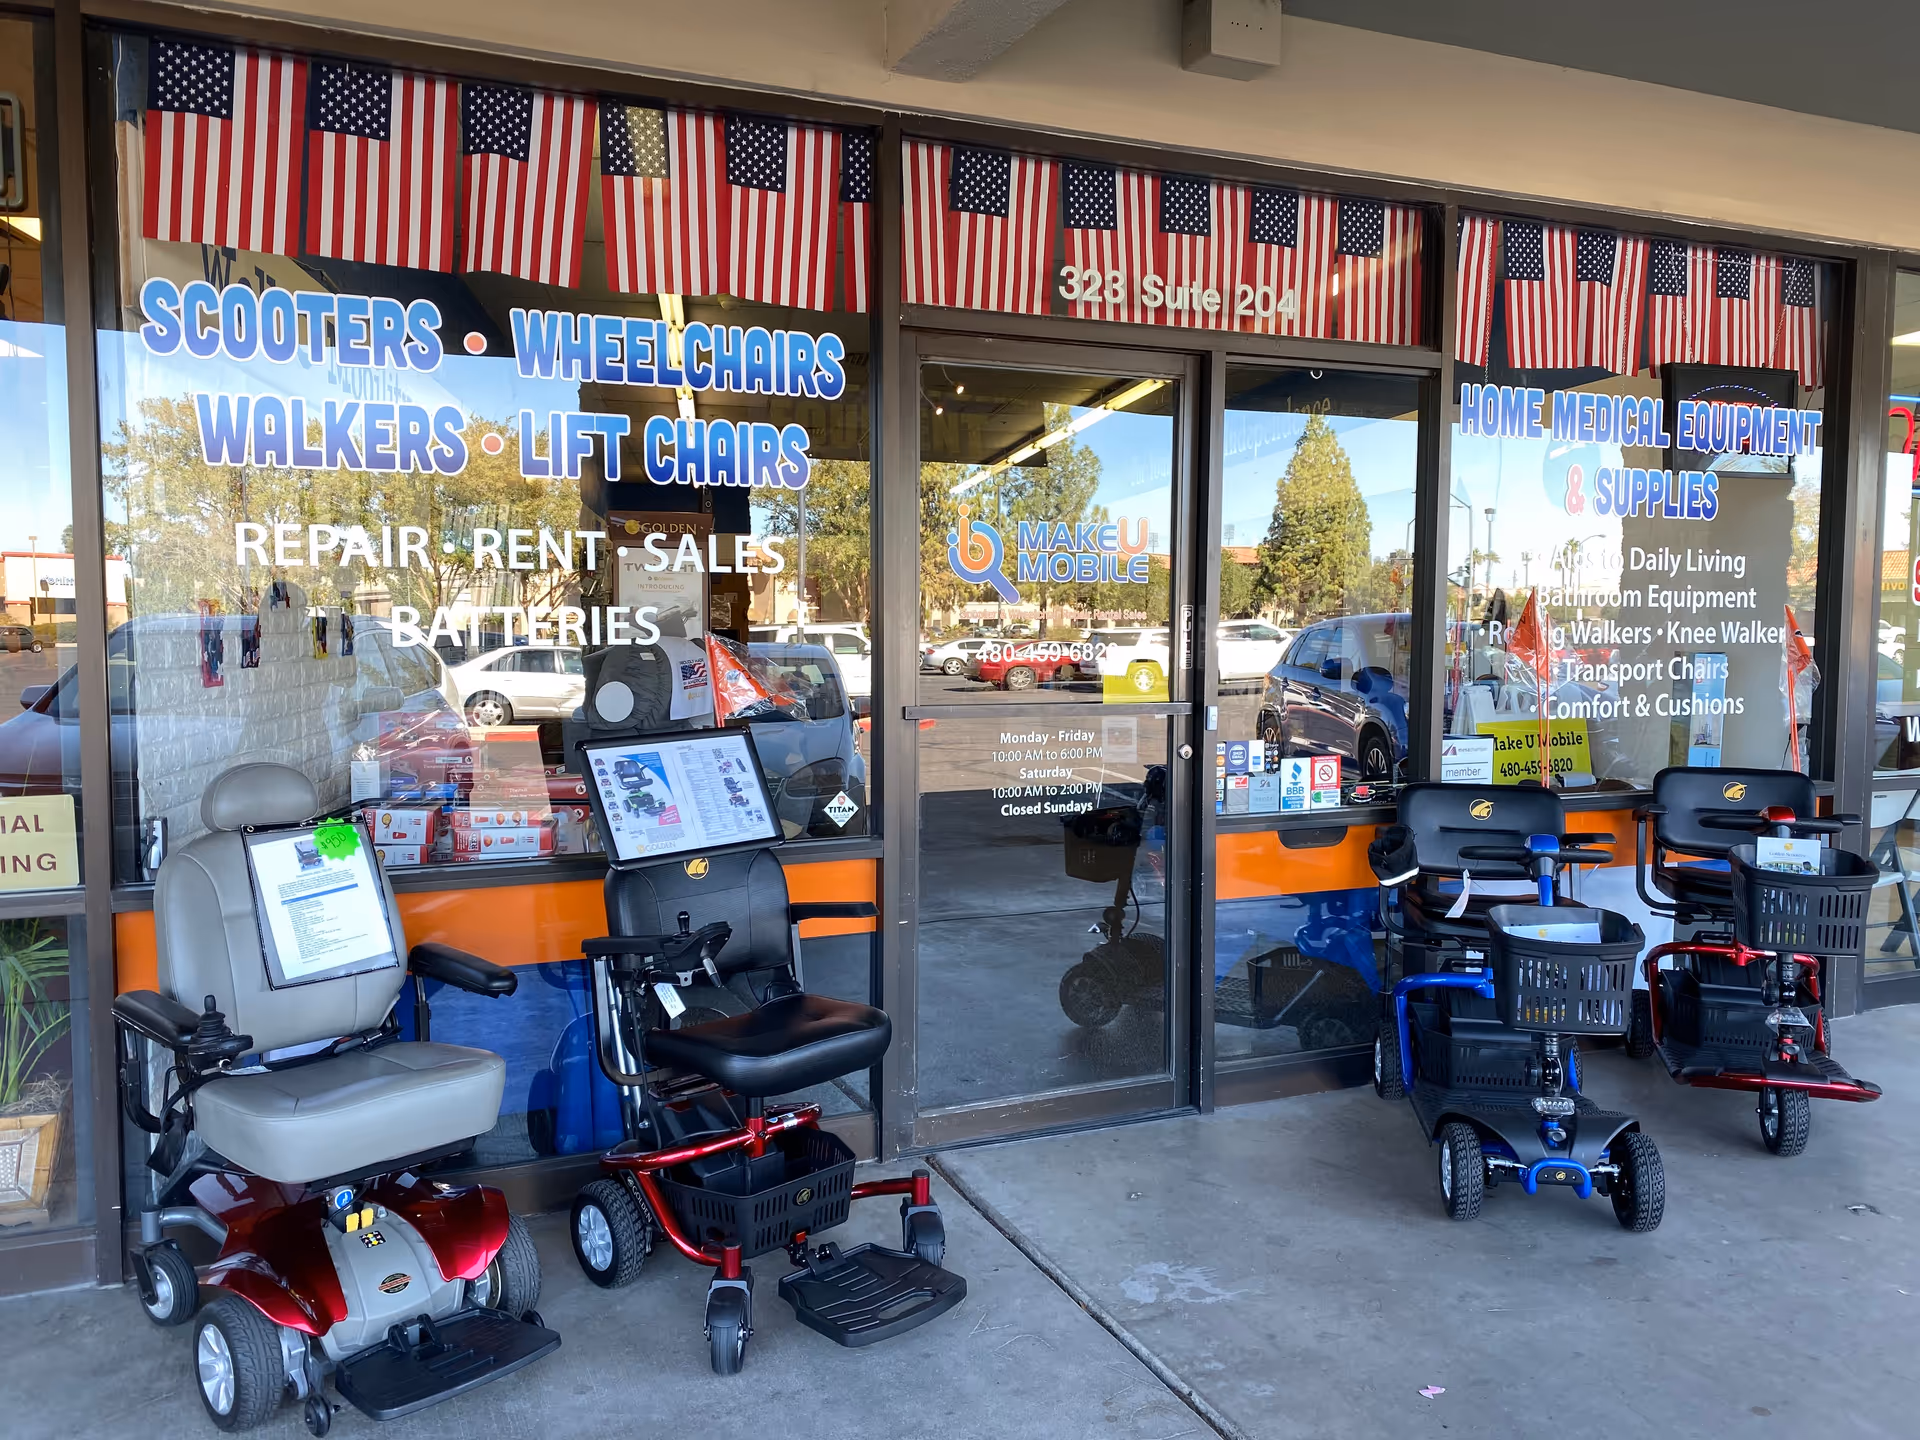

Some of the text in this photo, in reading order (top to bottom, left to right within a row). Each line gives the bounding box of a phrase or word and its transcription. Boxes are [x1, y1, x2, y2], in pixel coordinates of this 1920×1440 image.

[1058, 265, 1296, 319] 323 Suite 204
[139, 277, 443, 373] SCOOTERS
[509, 308, 846, 400] WHEELCHAIRS
[1460, 383, 1545, 439] HOME
[1552, 389, 1671, 449] MEDICAL
[1677, 399, 1823, 456] EQUIPMENT
[193, 392, 468, 476] WALKERS
[518, 409, 630, 482] LIFT
[644, 415, 811, 490] CHAIRS
[1566, 464, 1719, 521] & SUPPLIES
[640, 522, 697, 535] GOLDEN
[235, 522, 785, 575] REPAIR RENT SALES
[624, 562, 696, 573] TWGHT
[1017, 552, 1149, 584] MOBILE
[1630, 546, 1682, 577] Daily
[1686, 548, 1746, 578] Living
[1536, 584, 1757, 613] Bathroom Equipment
[392, 605, 661, 648] BATTERIES
[1094, 609, 1122, 621] Rental
[1123, 610, 1147, 621] Sales
[1570, 620, 1651, 645] Walkers
[1667, 621, 1717, 644] Knee
[975, 641, 1120, 663] 480-459-682
[1562, 655, 1729, 687] Transport Chairs
[1543, 693, 1744, 720] Comfort & Cushions
[1000, 731, 1049, 745] Monday
[1058, 730, 1095, 743] Friday
[1525, 734, 1535, 749] U
[1537, 731, 1583, 748] Mobile
[991, 746, 1103, 762] 10:00 AM to 6:00 PM
[1019, 766, 1073, 780] Saturday
[1445, 767, 1481, 778] member
[991, 782, 1103, 799] 10:00 AM to 2:00 PM
[1286, 786, 1305, 795] BBB
[1001, 800, 1093, 817] Closed Sundays
[645, 841, 676, 852] GOLDEN
